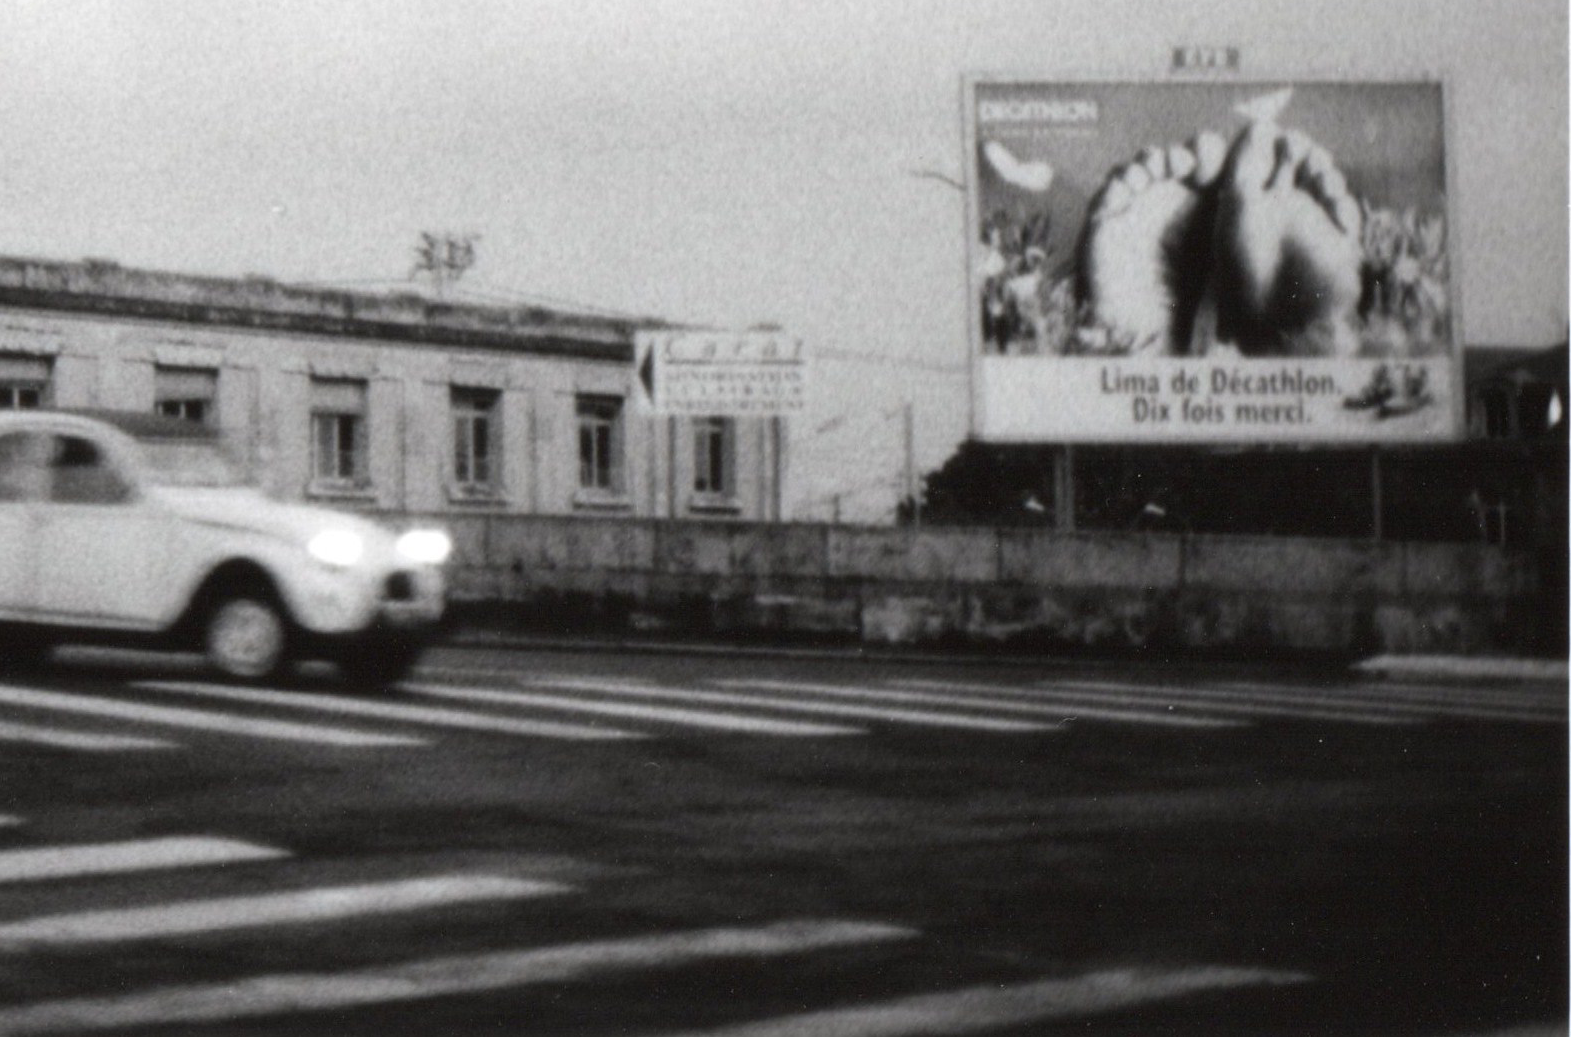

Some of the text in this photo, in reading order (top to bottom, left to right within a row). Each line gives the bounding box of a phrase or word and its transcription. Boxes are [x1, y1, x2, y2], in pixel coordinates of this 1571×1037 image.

[1100, 366, 1160, 394] Lima
[1170, 367, 1199, 394] de
[1132, 396, 1313, 424] Dix fois merci.
